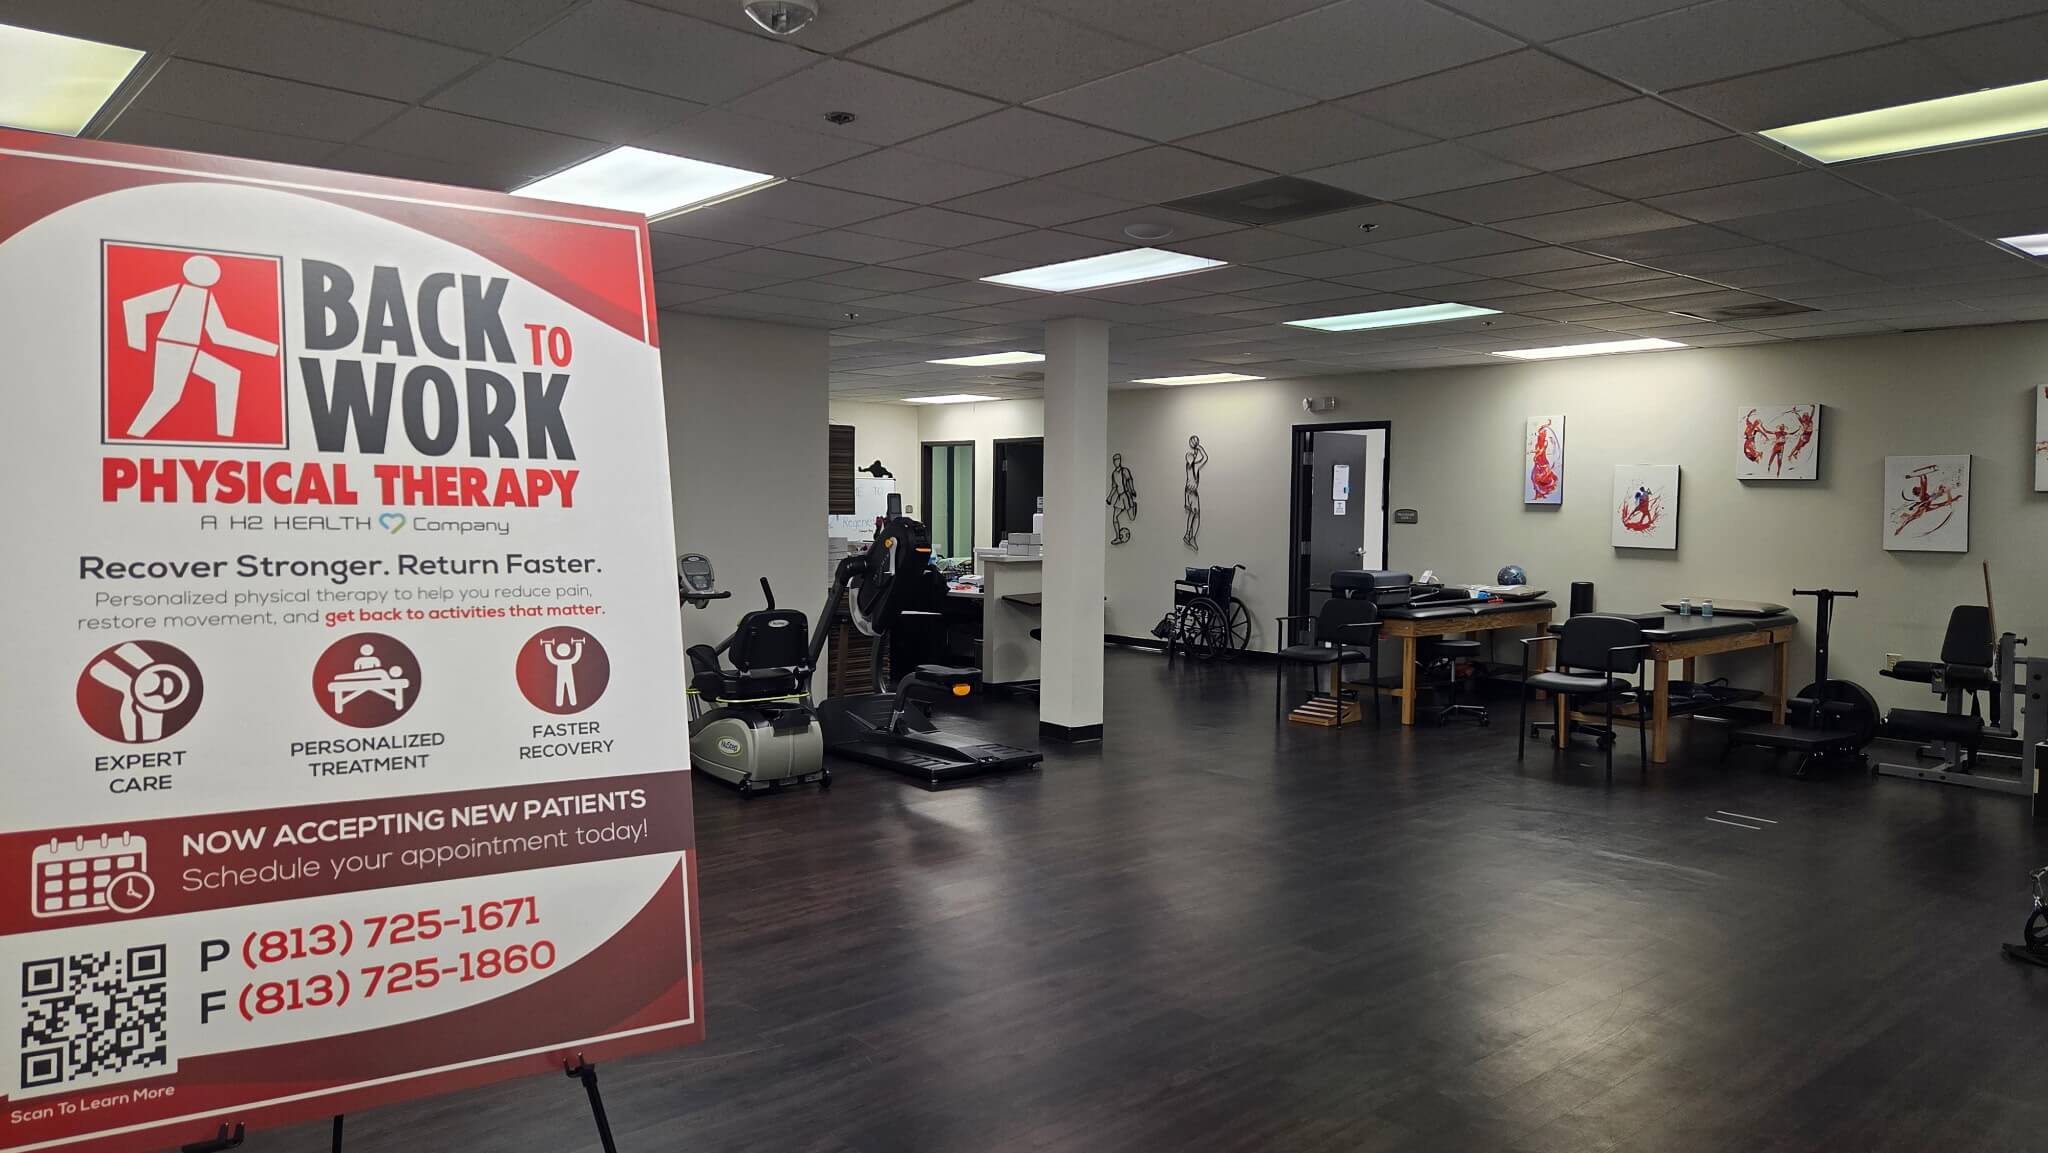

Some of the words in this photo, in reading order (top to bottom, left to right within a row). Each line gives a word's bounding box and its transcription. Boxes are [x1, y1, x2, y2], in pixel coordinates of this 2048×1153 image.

[301, 257, 517, 364] BACK
[523, 322, 574, 367] TO
[298, 357, 577, 461] WORK
[101, 457, 359, 505] PHYSICAL
[373, 464, 581, 508] THERAPY
[200, 514, 218, 530] A
[229, 514, 264, 530] H2
[273, 514, 373, 531] HEALTH
[412, 516, 510, 535] Company
[79, 554, 229, 581] Recover
[235, 554, 390, 584] Stronger.
[397, 553, 500, 577] Return
[505, 553, 602, 576] Faster.
[94, 587, 229, 607] Personalized
[234, 586, 312, 608] physical
[316, 586, 389, 606] therapy
[394, 587, 413, 601] to
[417, 584, 454, 606] help
[457, 587, 490, 603] you
[494, 584, 551, 598] reduce
[555, 585, 593, 600] pain,
[77, 613, 157, 631] restore
[163, 610, 278, 629] movement,
[282, 607, 319, 625] and
[325, 608, 354, 629] get
[358, 605, 401, 623] back
[405, 607, 424, 621] to
[428, 603, 506, 621] activities
[509, 602, 542, 618] that
[546, 602, 605, 618] matter.
[531, 720, 601, 739] FASTER
[290, 732, 445, 758] PERSONALIZED
[518, 739, 614, 760] RECOVERY
[94, 750, 187, 774] EXPERT
[308, 754, 429, 778] TREATMENT
[109, 774, 173, 794] CARE
[181, 827, 267, 858] NOW
[272, 810, 445, 846] ACCEPTING
[451, 798, 519, 828] NEW
[524, 788, 647, 819] PATIENTS
[181, 857, 322, 893] Schedule
[328, 848, 393, 881] your
[400, 827, 569, 869] appointment
[575, 818, 650, 849] today!
[200, 939, 231, 973] P
[242, 920, 355, 971] (813)
[363, 896, 540, 948] 725-1671
[201, 990, 227, 1026] F
[238, 970, 352, 1022] (813)
[360, 939, 556, 999] 725-1860
[10, 1106, 54, 1125] Scan
[57, 1101, 76, 1116] To
[80, 1093, 129, 1114] Learn
[133, 1084, 175, 1102] More
